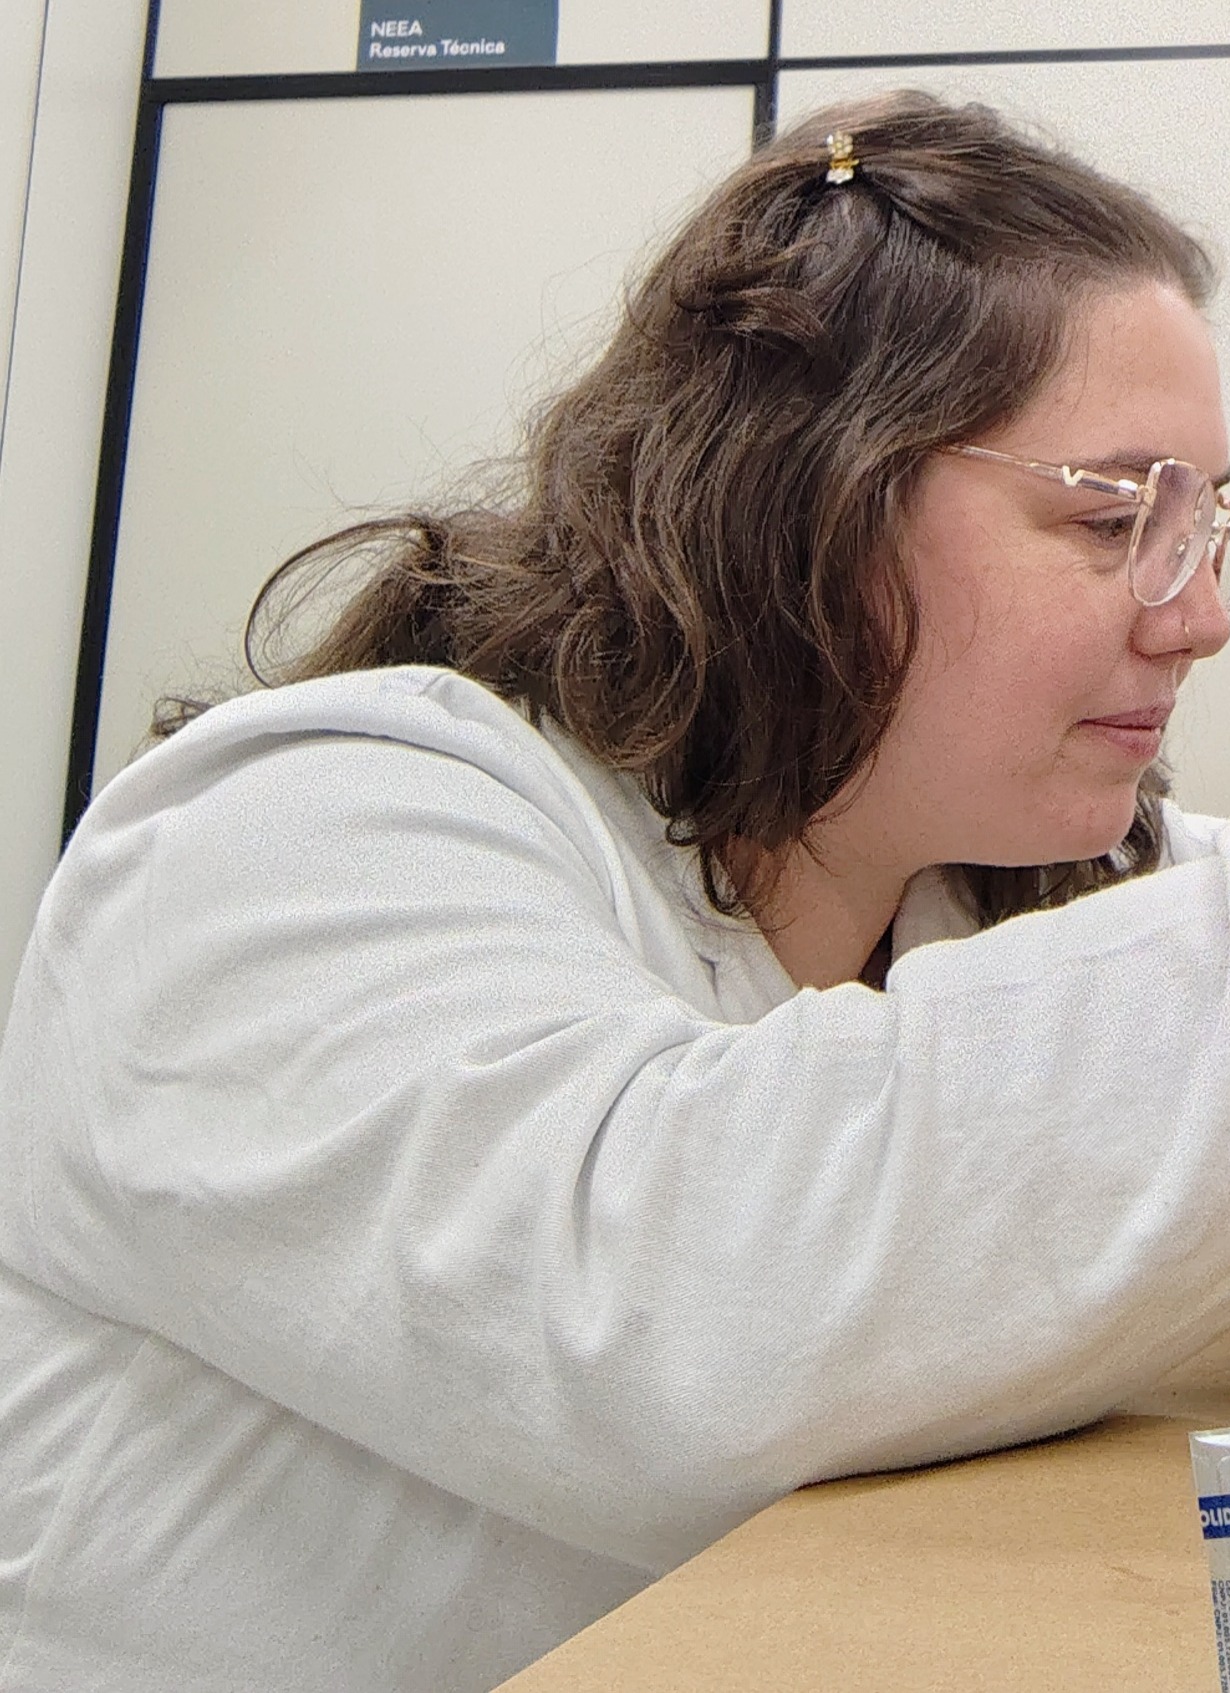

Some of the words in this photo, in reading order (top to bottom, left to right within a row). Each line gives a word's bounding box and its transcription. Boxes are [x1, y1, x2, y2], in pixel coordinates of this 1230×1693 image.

[370, 20, 423, 37] NEEA
[369, 42, 437, 58] Reserva
[441, 38, 506, 56] Técnica
